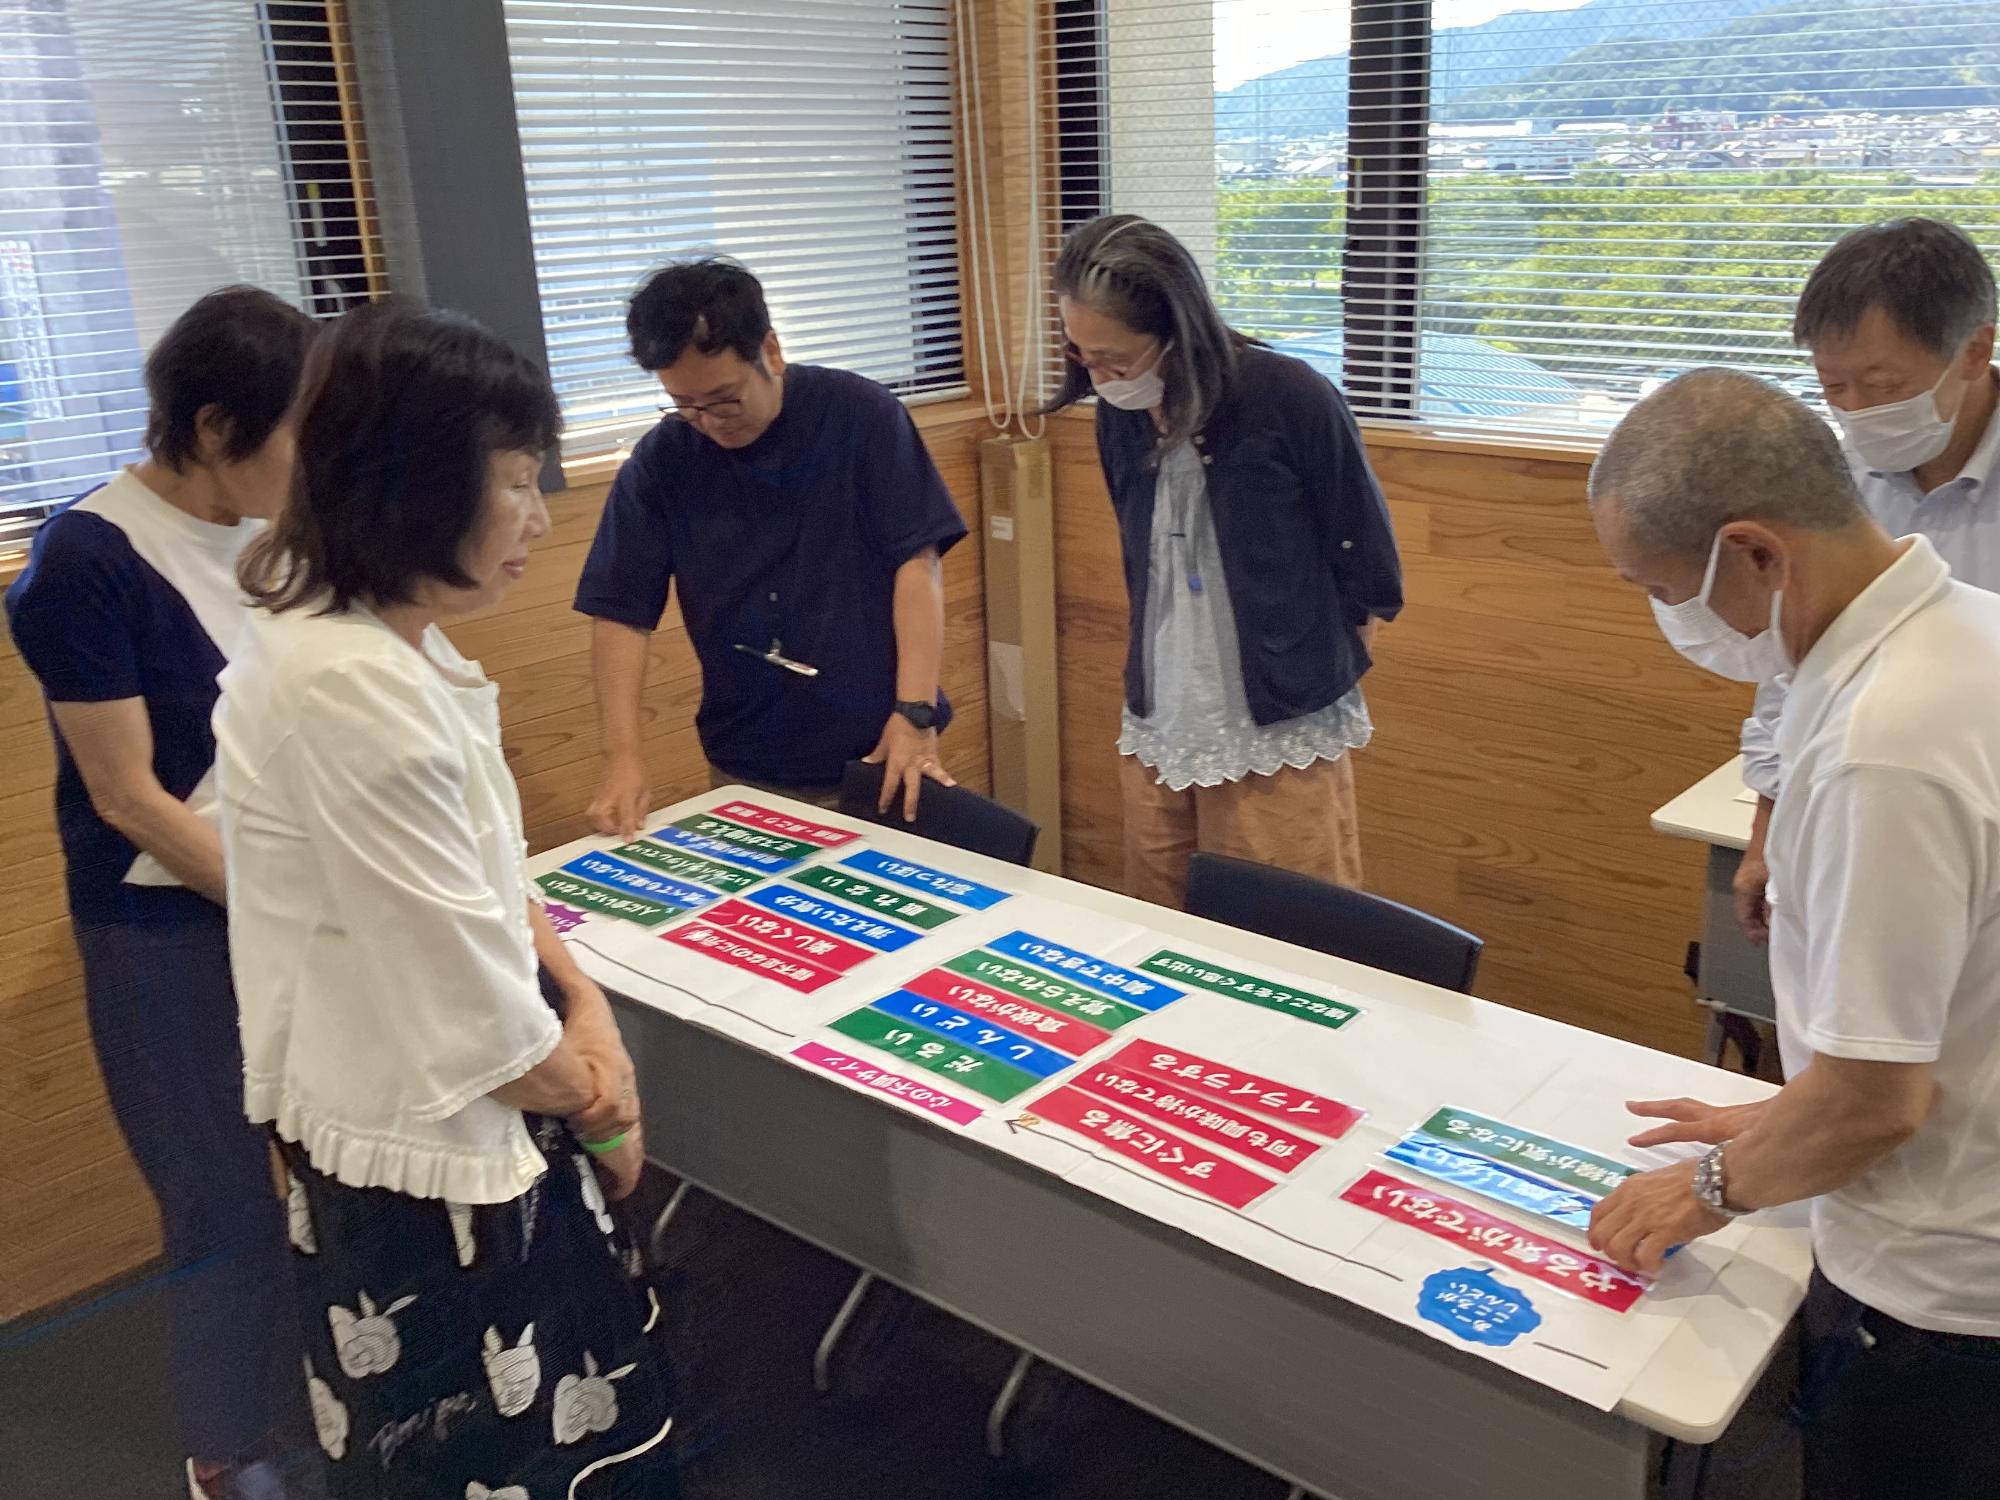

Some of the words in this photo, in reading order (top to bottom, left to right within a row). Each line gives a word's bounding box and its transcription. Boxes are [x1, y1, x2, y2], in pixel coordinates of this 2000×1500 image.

[696, 822, 796, 851] ミスが増える
[547, 881, 661, 915] 人に会いたくない
[822, 876, 928, 916] 眠れない
[878, 862, 974, 895] 忘れっぽい
[738, 915, 838, 955] 楽しくない
[775, 896, 895, 939] 消えたい気分
[977, 962, 1114, 1015] 覚えられない
[1020, 943, 1154, 995] 集中できない
[1151, 959, 1350, 1019] 嫌なことをすぐ思い出す
[912, 1004, 1034, 1060] しんどい
[949, 986, 1069, 1032] 食欲がない
[885, 1030, 984, 1072] だるい
[823, 1058, 952, 1107] 心の不調サイン
[1150, 1054, 1320, 1113] イライラする
[1096, 1073, 1297, 1157] 何も興味が持てない
[1080, 1110, 1216, 1178] すぐに焦る
[1373, 1186, 1620, 1291] やる気がでない
[1436, 1293, 1510, 1323] こころが
[1450, 1283, 1519, 1313] しんどい
